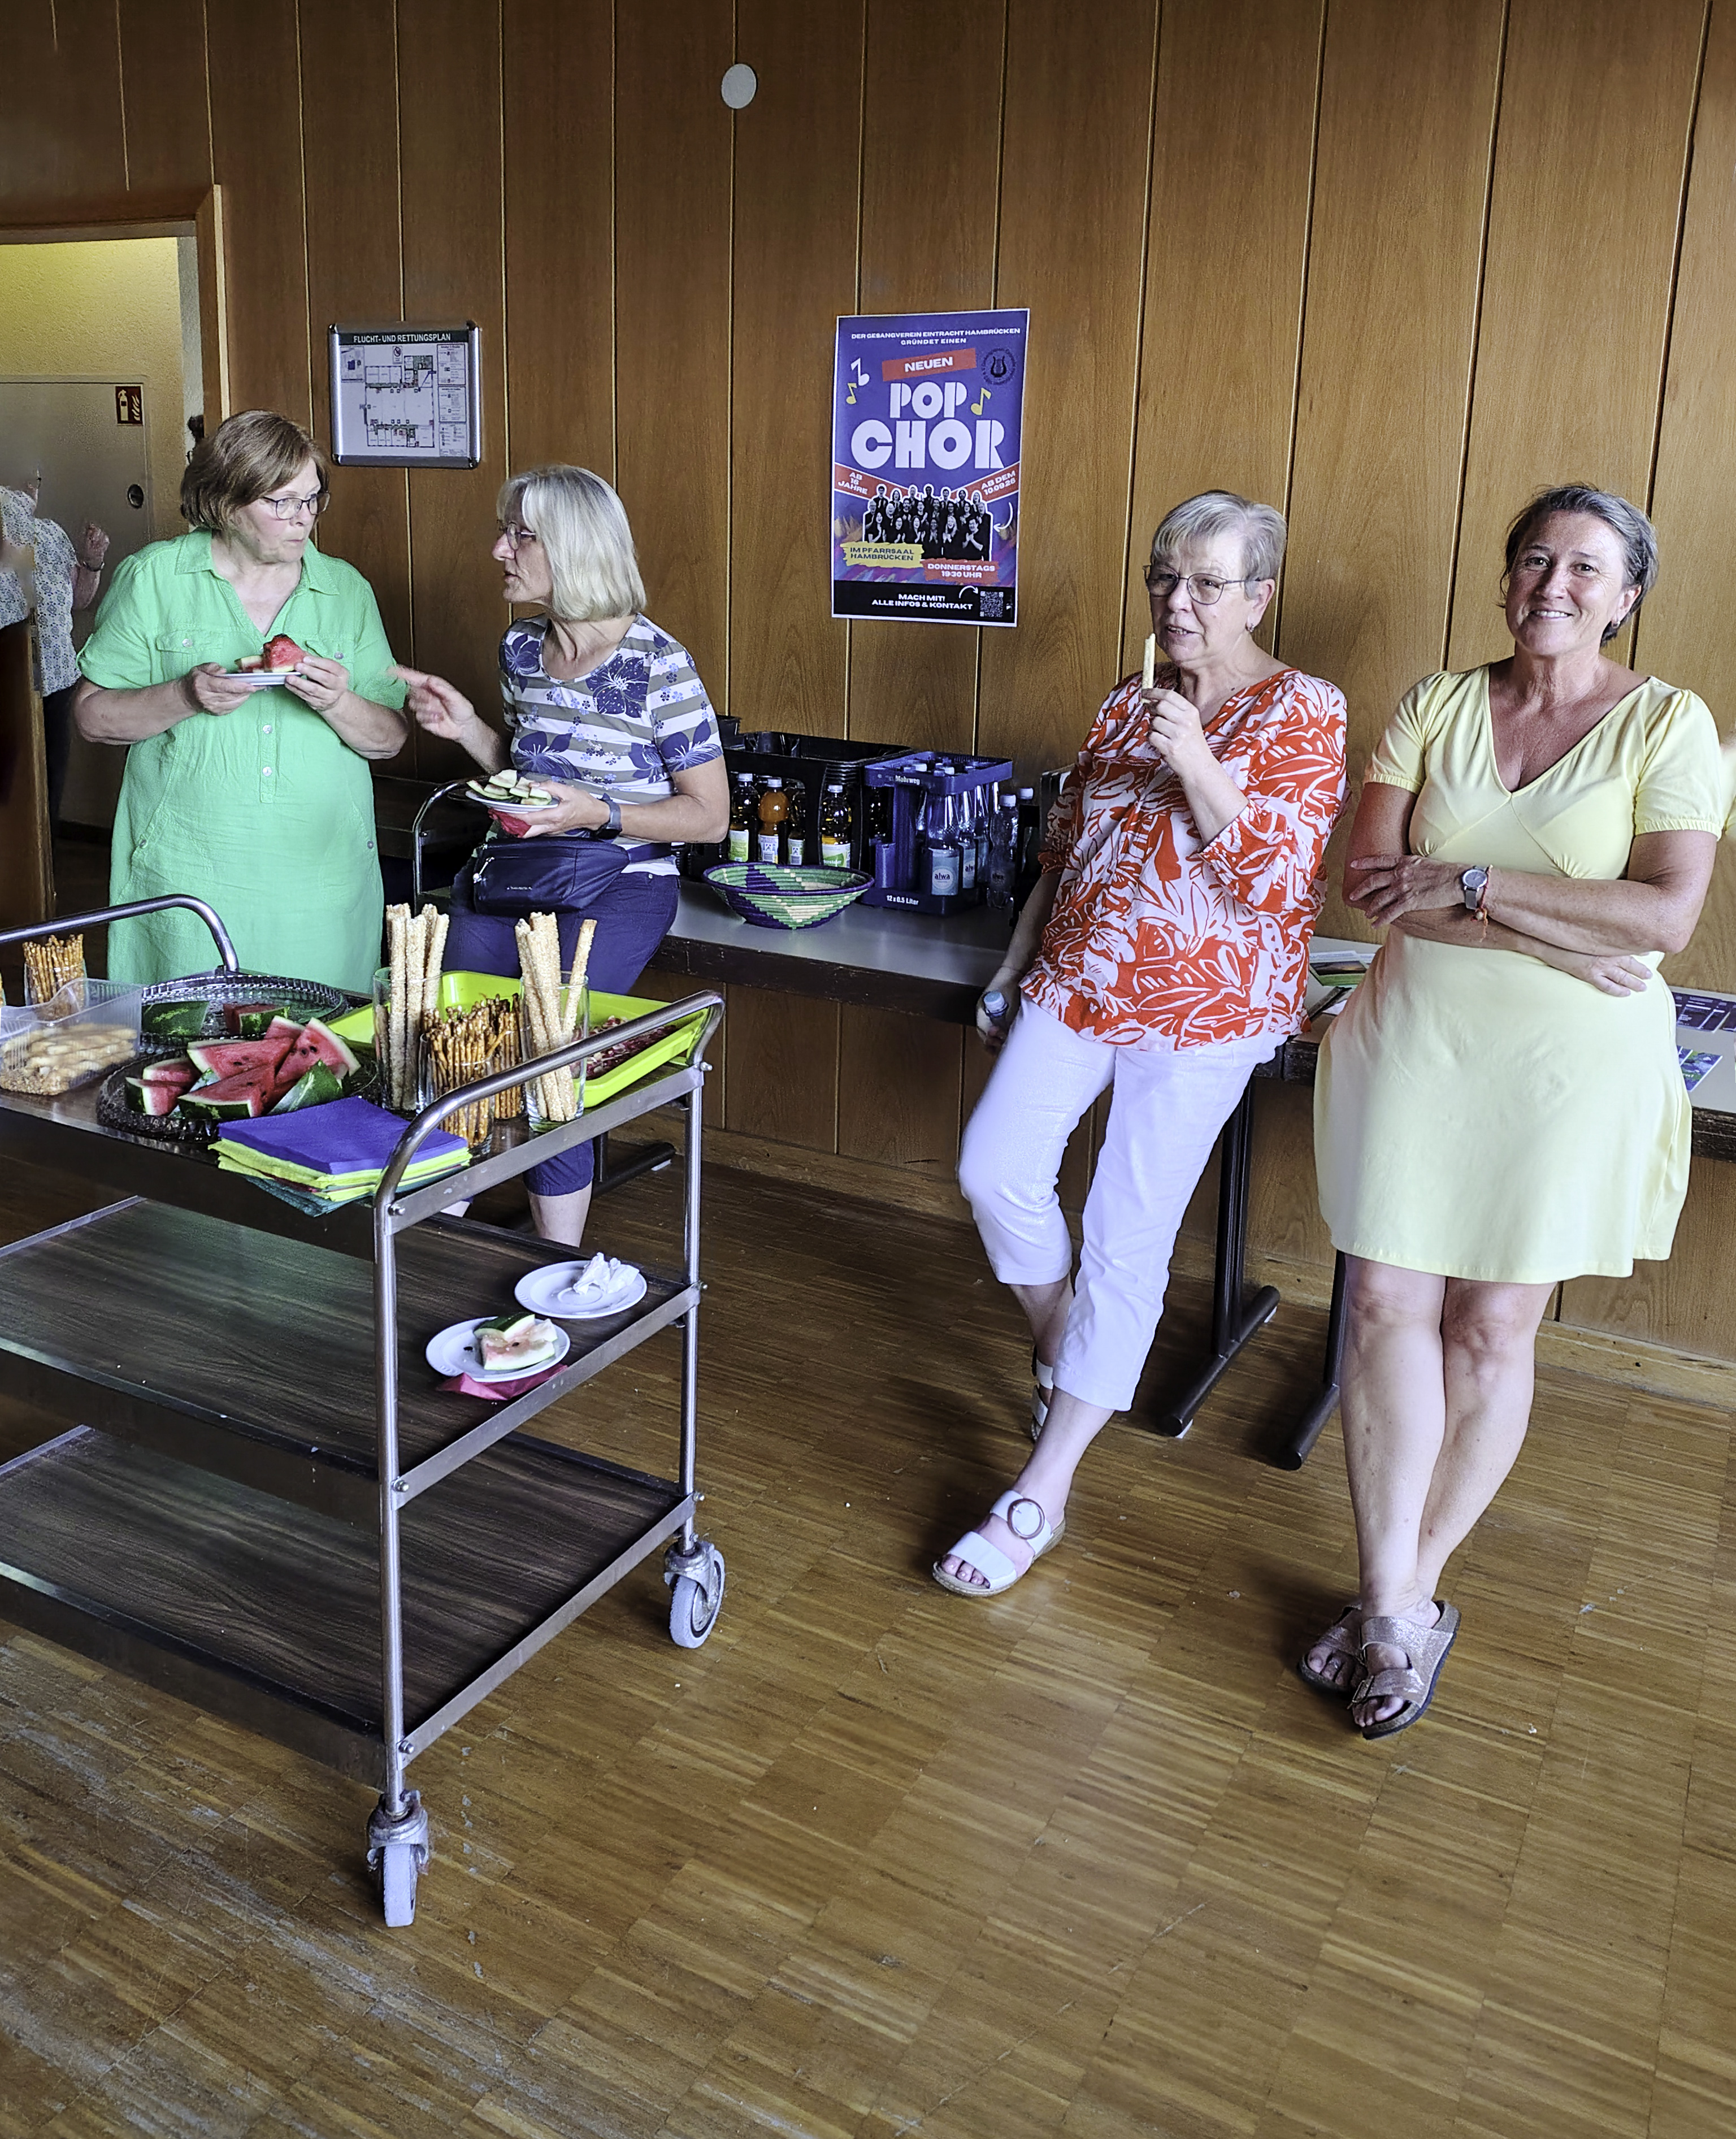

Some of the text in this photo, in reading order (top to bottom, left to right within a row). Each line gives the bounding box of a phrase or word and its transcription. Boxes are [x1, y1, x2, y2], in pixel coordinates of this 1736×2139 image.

[397, 333, 451, 342] RETTUNGSPLAN
[905, 357, 953, 373] NEUEN
[889, 381, 967, 419] POP
[851, 419, 1005, 470] CHOR
[849, 472, 862, 480] AB
[982, 470, 1015, 490] AB DEM
[837, 480, 868, 494] JAHRE
[927, 563, 995, 571] DONNERSTAGS
